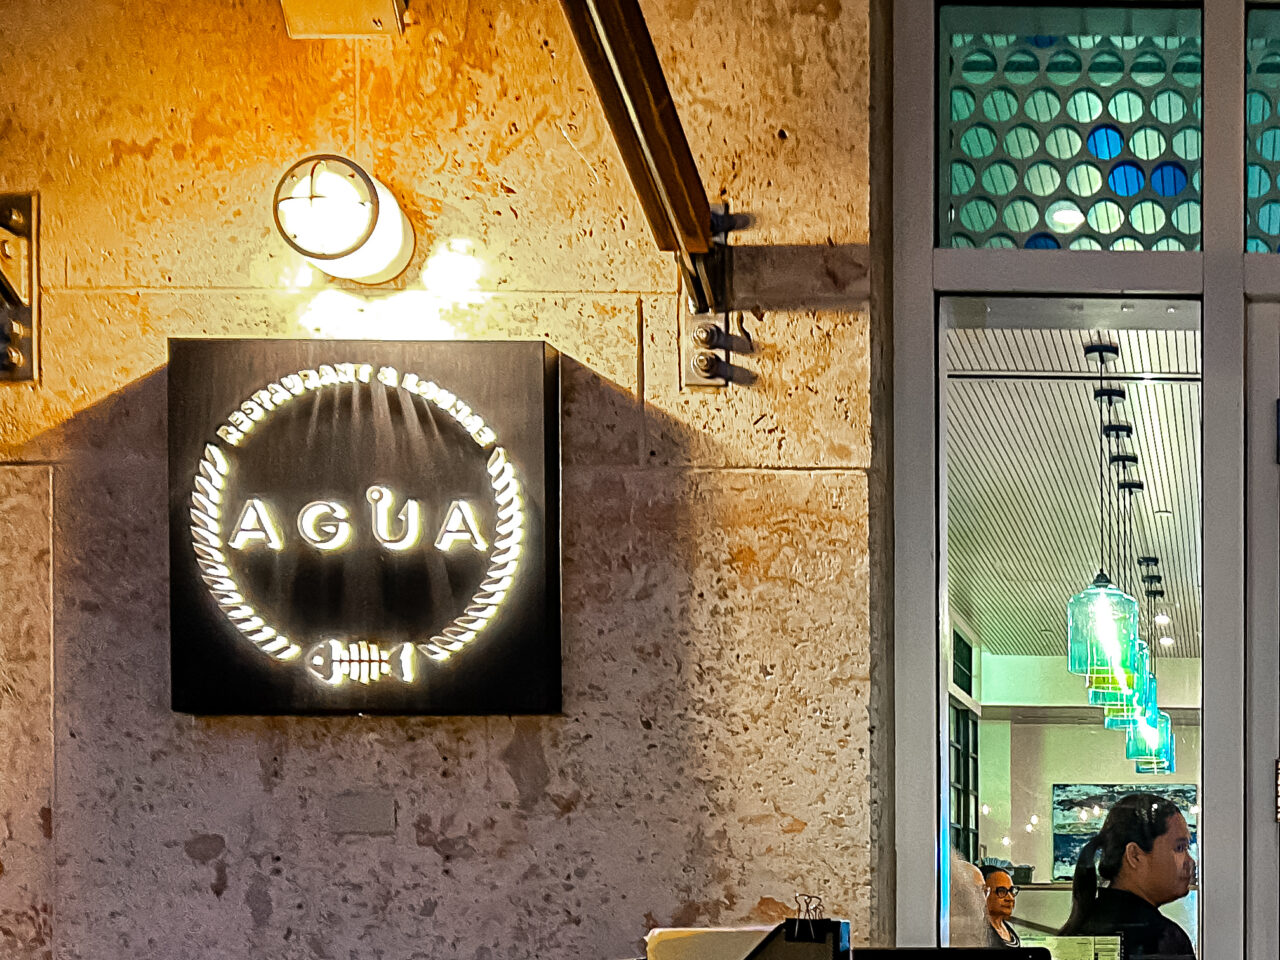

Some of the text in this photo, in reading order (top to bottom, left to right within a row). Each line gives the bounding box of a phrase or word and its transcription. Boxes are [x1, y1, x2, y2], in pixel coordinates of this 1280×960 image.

[216, 362, 497, 448] RESTAURANT & LOUNGE
[228, 485, 488, 552] AGUA
